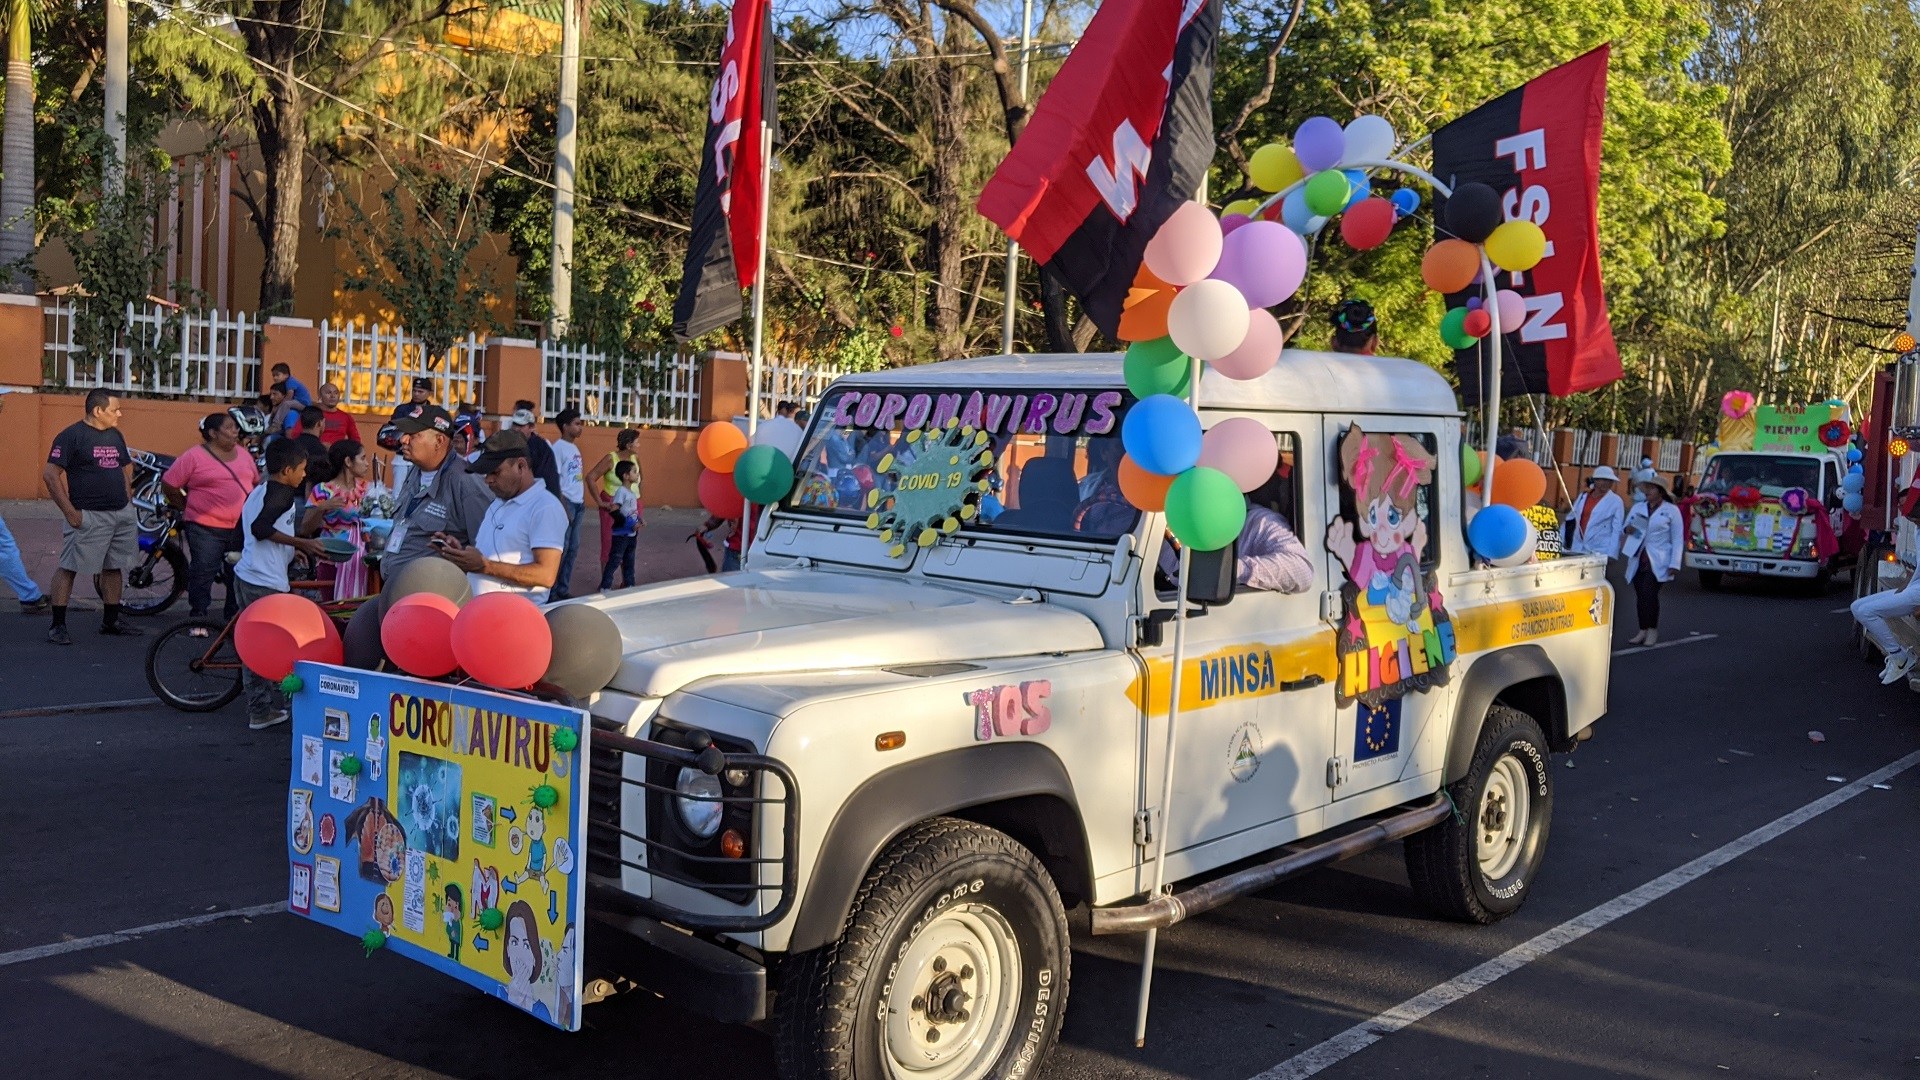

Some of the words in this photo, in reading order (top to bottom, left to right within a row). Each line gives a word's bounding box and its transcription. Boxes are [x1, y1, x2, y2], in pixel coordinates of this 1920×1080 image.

[834, 391, 1122, 435] CORONAVIRUS
[1775, 406, 1806, 415] AMOR
[1763, 424, 1809, 435] TIEMPO
[1799, 445, 1811, 453] 19
[898, 472, 940, 491] COVID
[1539, 598, 1566, 615] MANAGUA
[1520, 618, 1550, 638] FRANCISCO
[1549, 613, 1575, 632] BUITRAGO
[1344, 620, 1457, 698] HIGIENE
[1200, 649, 1275, 702] MINSA
[320, 680, 356, 695] CORONAVIRUS
[963, 680, 1052, 742] TOS
[1004, 968, 1053, 1080] DESTINA
